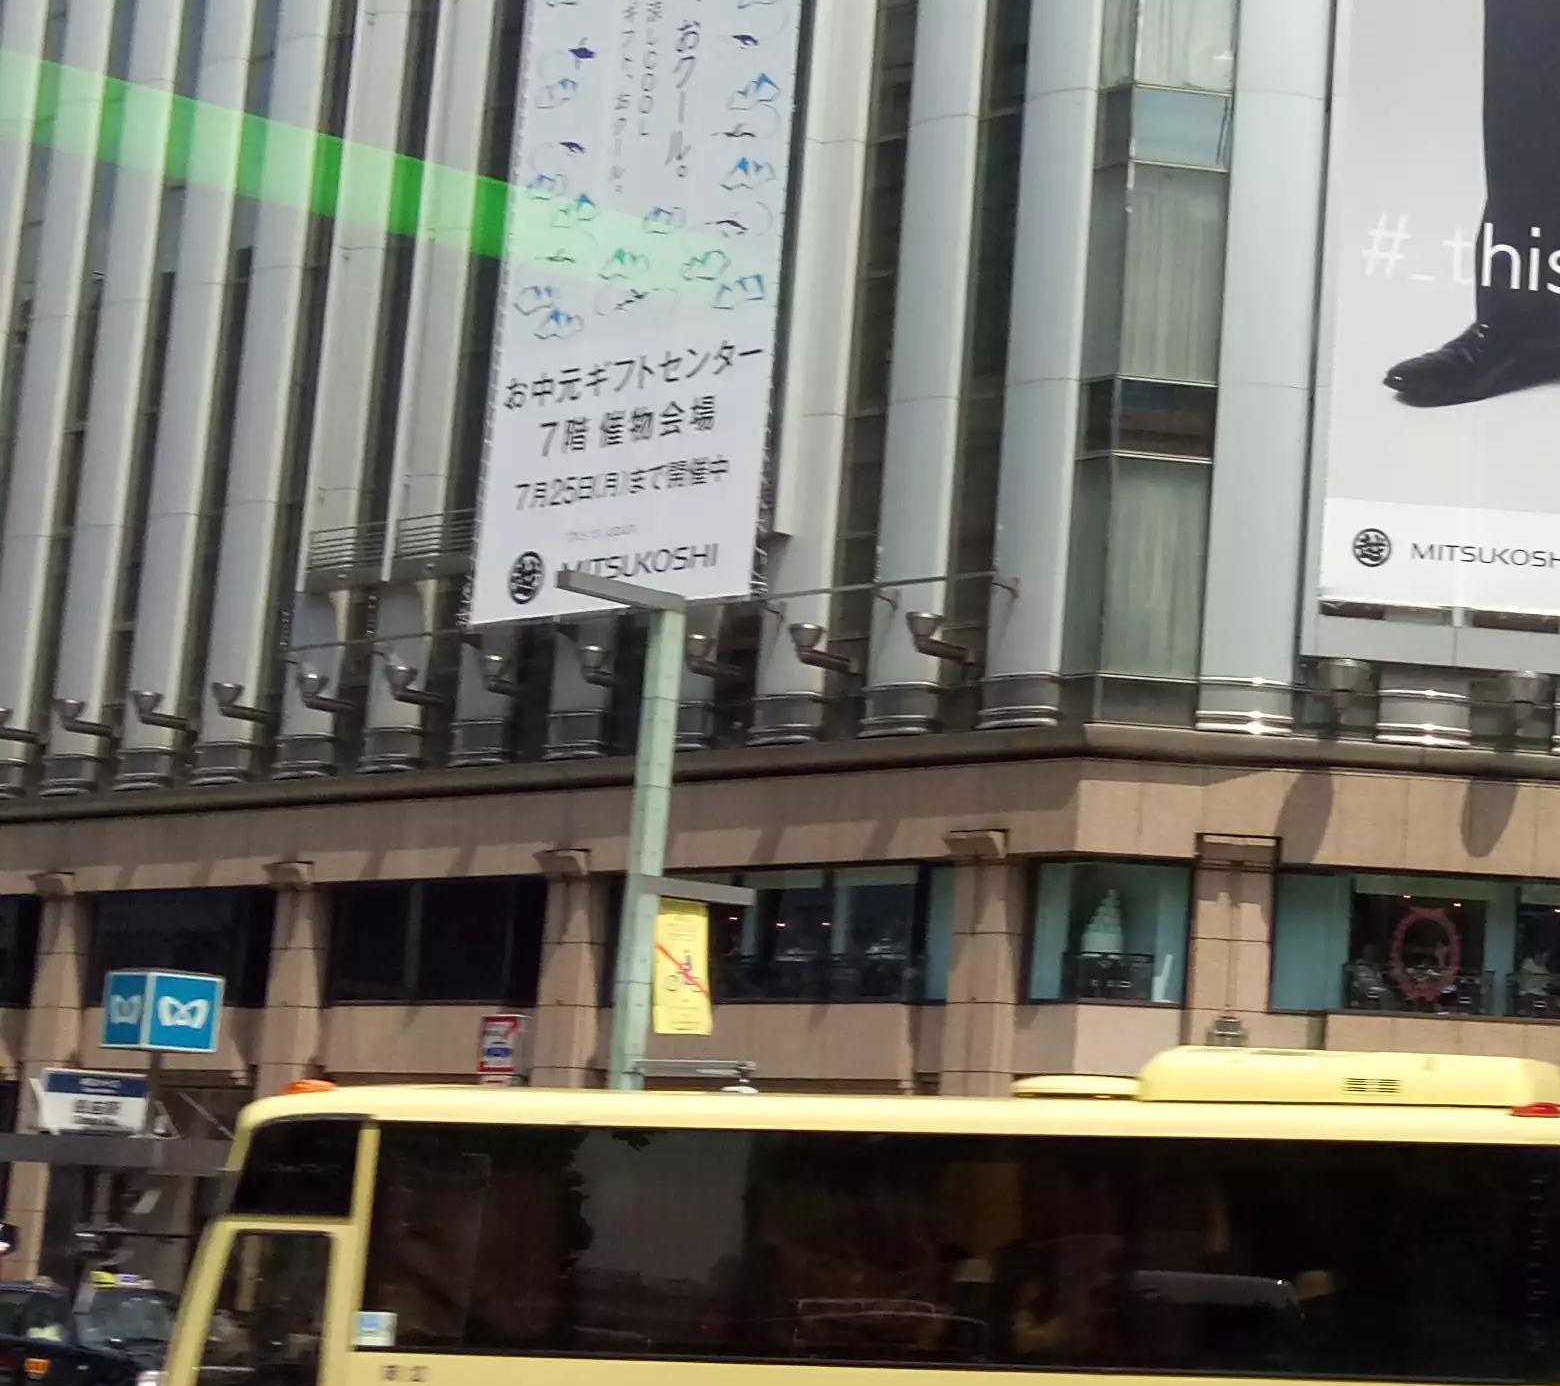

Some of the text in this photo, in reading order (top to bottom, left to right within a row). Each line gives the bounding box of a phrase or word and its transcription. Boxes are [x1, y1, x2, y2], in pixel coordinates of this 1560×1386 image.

[502, 340, 765, 410] お中元ギフトセンター
[538, 395, 717, 457] 7階 催物会場
